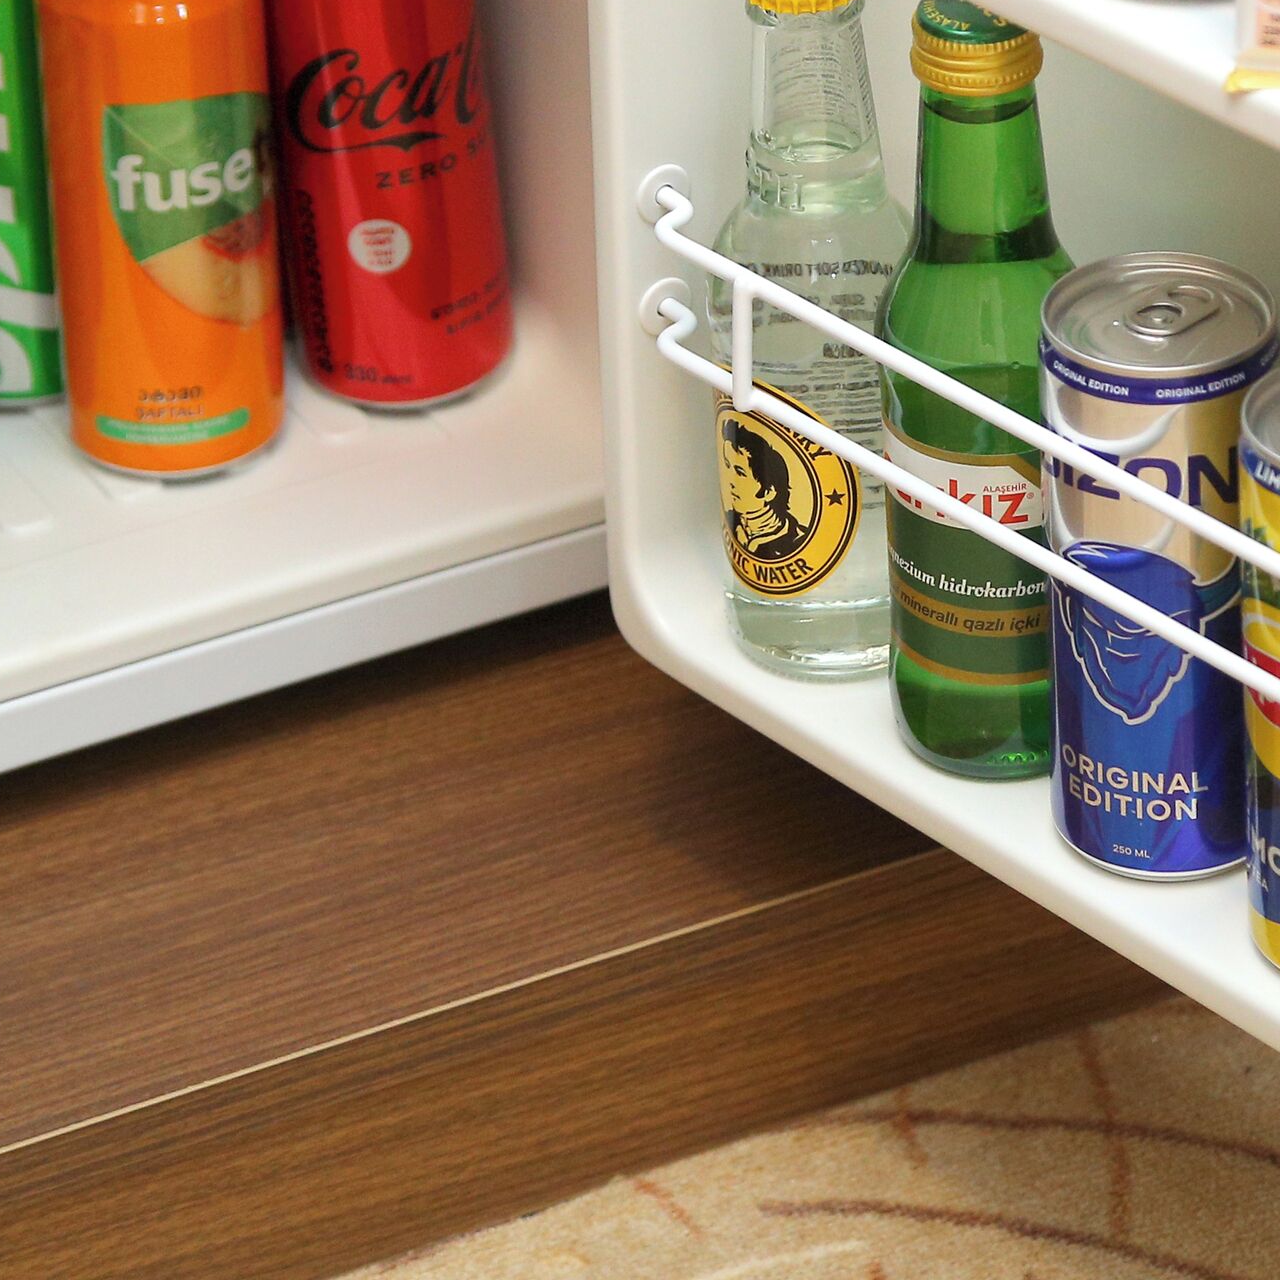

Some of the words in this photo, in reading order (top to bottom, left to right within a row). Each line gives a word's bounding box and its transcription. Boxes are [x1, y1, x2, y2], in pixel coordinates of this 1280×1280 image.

[113, 147, 253, 212] fuse
[375, 153, 458, 189] ZERO
[1053, 359, 1087, 386] ORIGINAL
[1088, 379, 1130, 397] EDITION
[1155, 384, 1207, 399] ORIGINAL
[1208, 372, 1246, 392] EDITION
[982, 482, 1028, 495] ALAŞEHİR
[723, 529, 750, 575] ONIC
[753, 558, 813, 585] WATER
[1010, 614, 1041, 632] içki
[1062, 744, 1209, 795] ORIGINAL
[1069, 780, 1198, 822] EDITION
[1113, 844, 1132, 856] 250
[1135, 848, 1150, 859] ML
